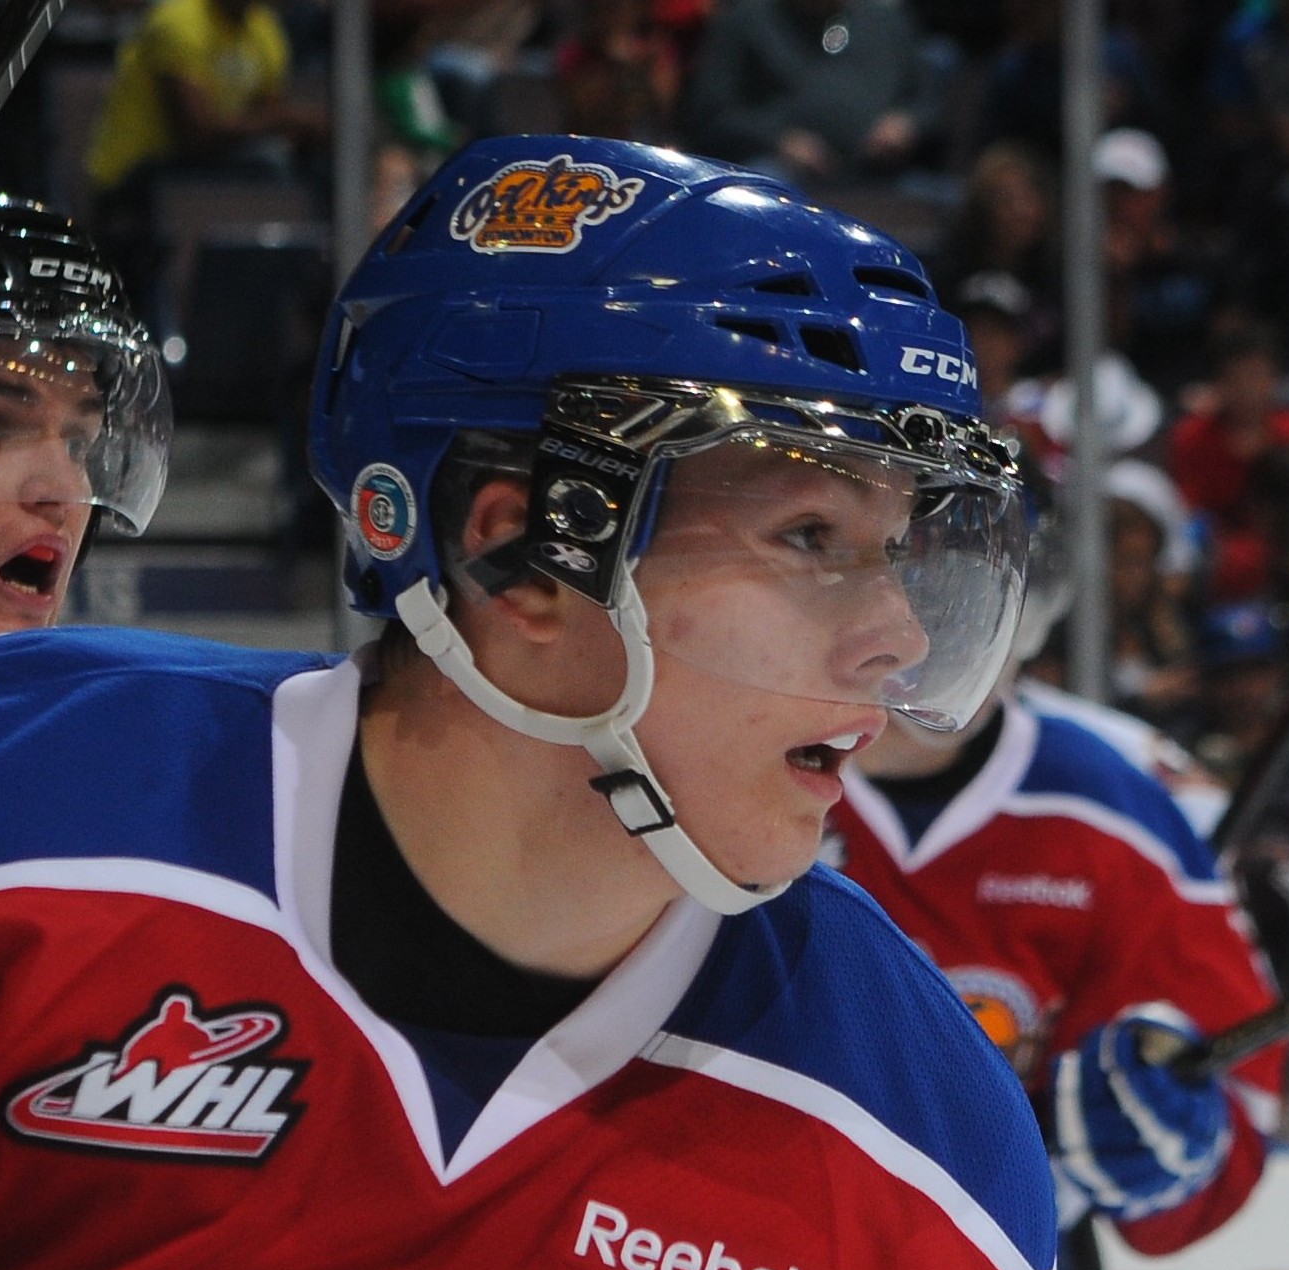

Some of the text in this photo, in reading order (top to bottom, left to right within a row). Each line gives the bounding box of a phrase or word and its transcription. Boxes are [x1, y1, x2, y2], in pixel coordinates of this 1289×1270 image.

[30, 258, 112, 295] CCM
[900, 346, 977, 390] CCM
[539, 437, 642, 482] BAUER
[61, 1050, 294, 1132] WHL
